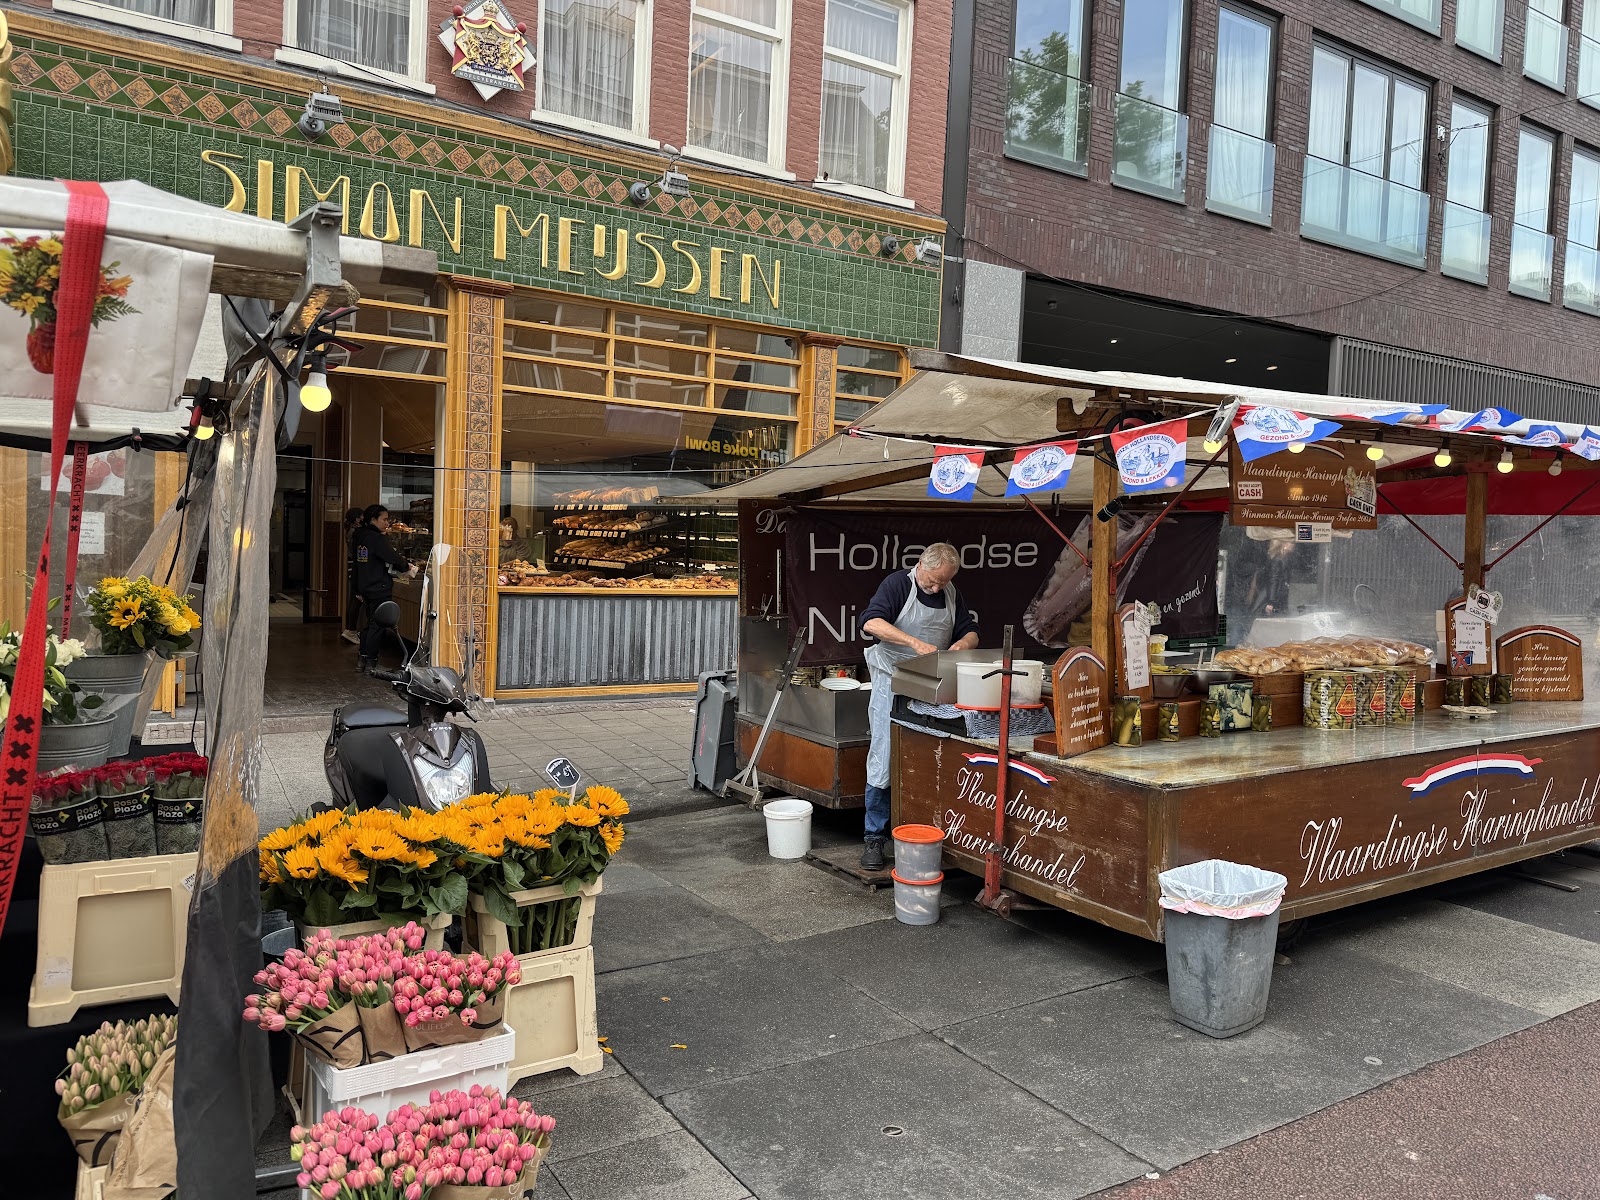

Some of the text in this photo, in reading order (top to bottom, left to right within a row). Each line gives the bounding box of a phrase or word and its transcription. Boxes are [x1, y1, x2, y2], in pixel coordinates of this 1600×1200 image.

[459, 72, 518, 90] HOFLEVERANCIER
[201, 150, 462, 254] SIMON
[1145, 468, 1168, 482] LEKKER
[1241, 461, 1301, 484] Vlaardingse
[1239, 488, 1262, 497] CASH
[1288, 493, 1310, 502] Anno
[1350, 497, 1374, 515] CASH ONLY
[1241, 507, 1274, 519] Winnaar
[1275, 509, 1309, 521] Hollandse
[1310, 511, 1335, 523] Haring
[809, 532, 1039, 572] Holladse
[1163, 602, 1174, 614] en
[1469, 606, 1494, 621] CASH ONLY
[1532, 643, 1549, 651] Hier
[1524, 653, 1541, 661] beste
[1542, 653, 1568, 664] haring
[1517, 664, 1543, 675] zonder
[1513, 674, 1571, 685] schoongemaakt
[113, 798, 139, 808] Rosa
[157, 803, 180, 811] Rosa
[956, 767, 1069, 837] Vlaadingse
[76, 804, 99, 816] Rosa
[114, 804, 143, 814] Plaza
[157, 810, 184, 818] Plaza
[1300, 773, 1600, 888] Vlaardingse Haringhandel
[943, 808, 1086, 889] Harihandel
[410, 1020, 454, 1031] ULIFLOR
